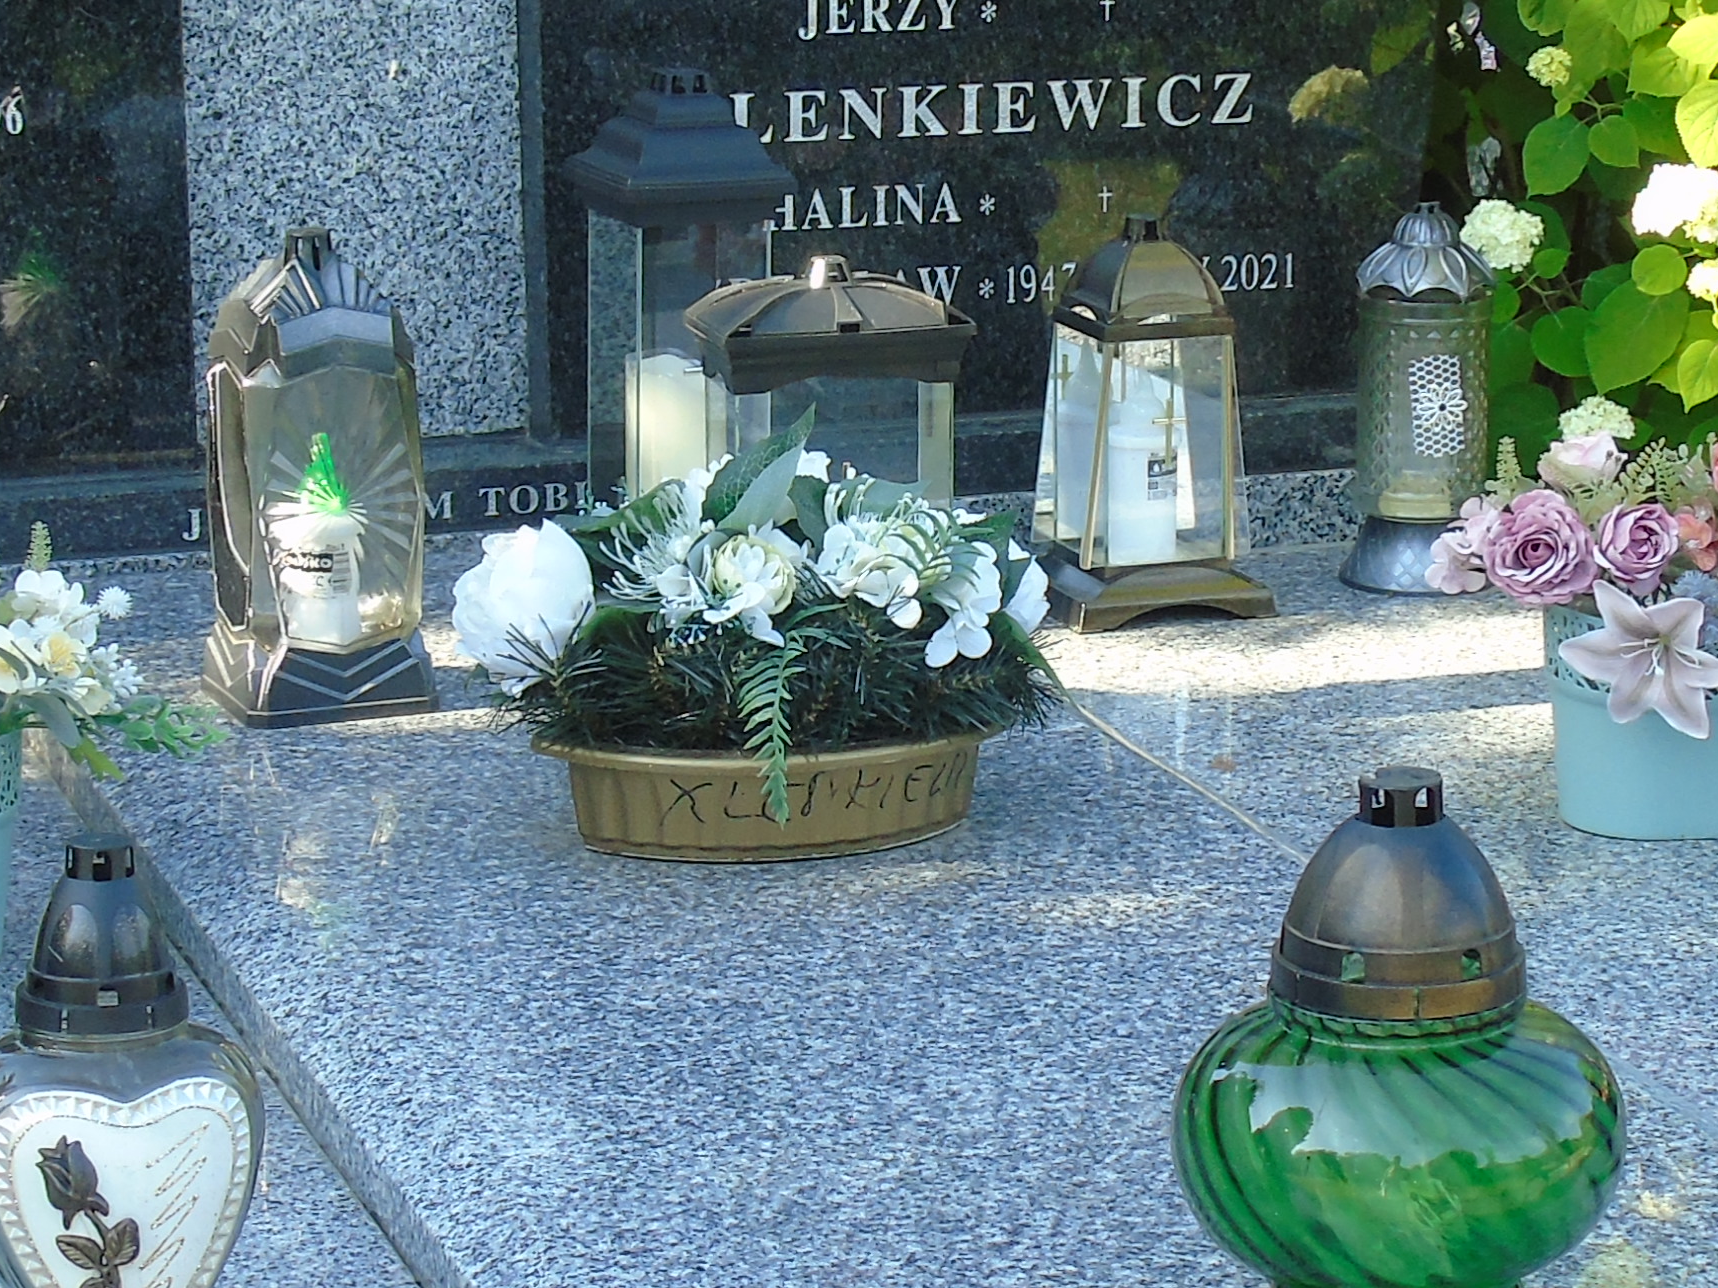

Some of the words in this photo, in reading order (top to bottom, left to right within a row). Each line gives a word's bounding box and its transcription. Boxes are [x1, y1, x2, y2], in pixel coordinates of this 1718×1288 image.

[729, 71, 1254, 145] LENKIEWICZ
[1220, 252, 1295, 291] 2021
[478, 480, 591, 517] TOBI
